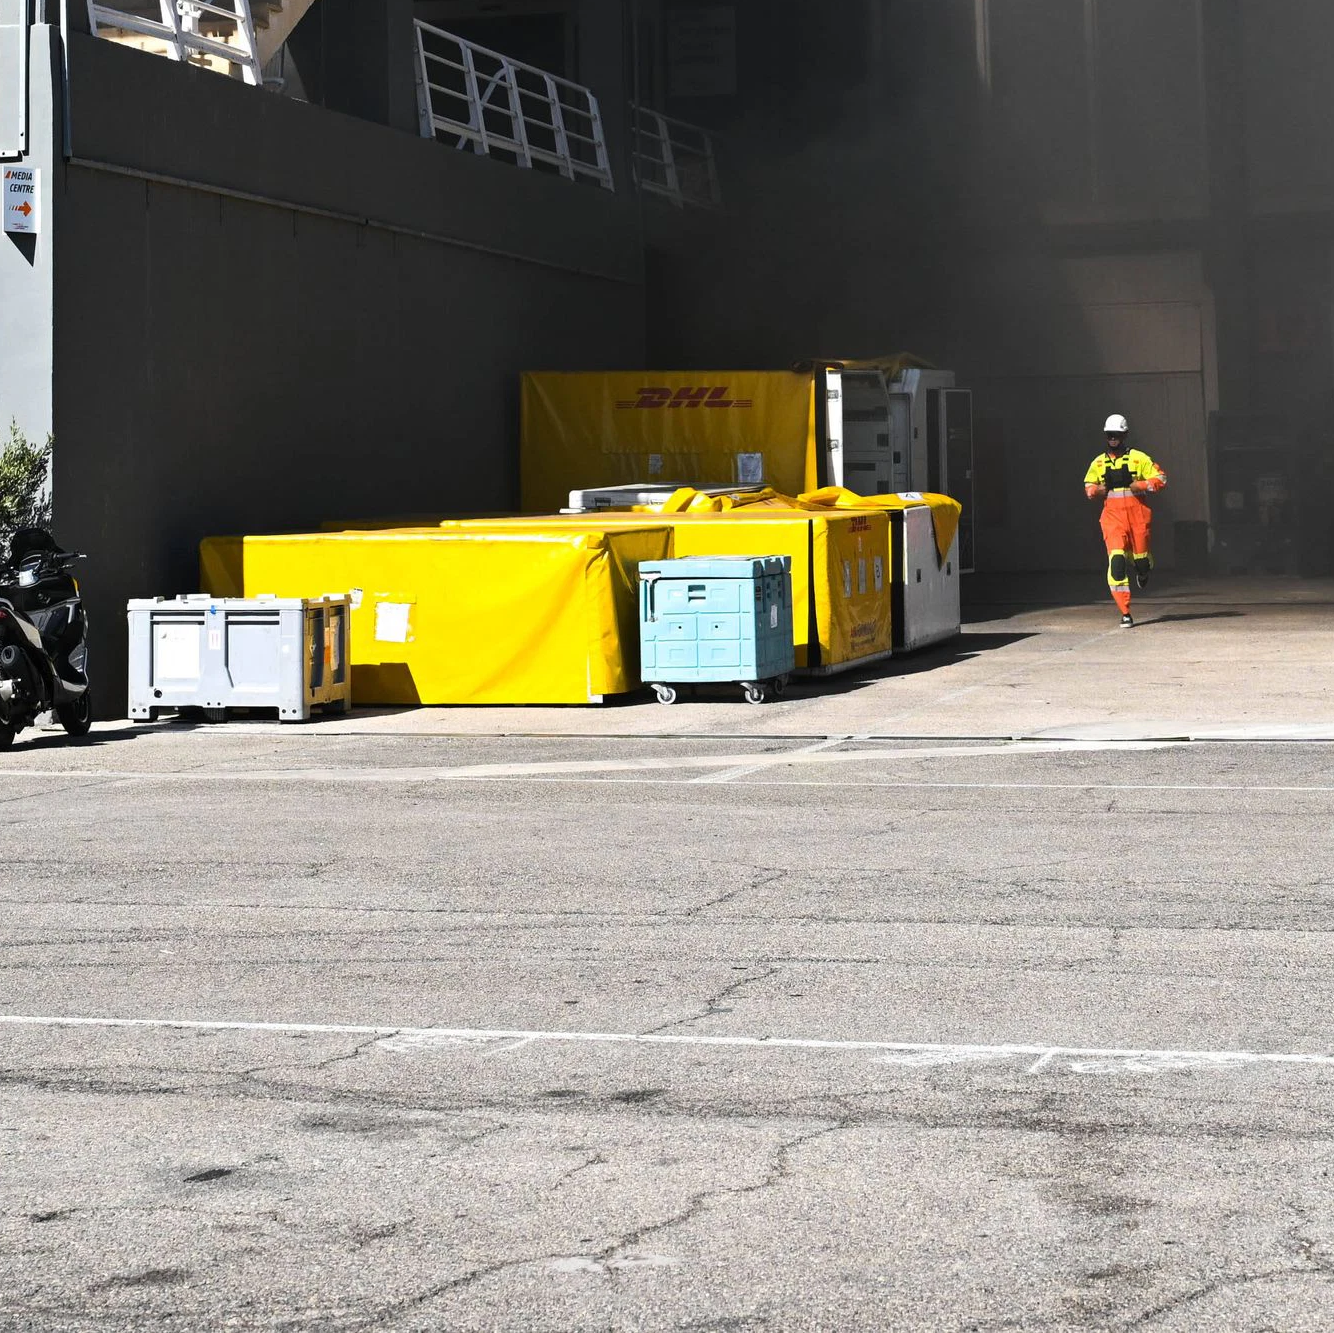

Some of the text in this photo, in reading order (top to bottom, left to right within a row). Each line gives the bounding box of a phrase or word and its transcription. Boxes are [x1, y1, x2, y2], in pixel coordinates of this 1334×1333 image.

[11, 171, 33, 181] MEDIA
[9, 183, 35, 194] CENTRE
[634, 386, 734, 409] DHL
